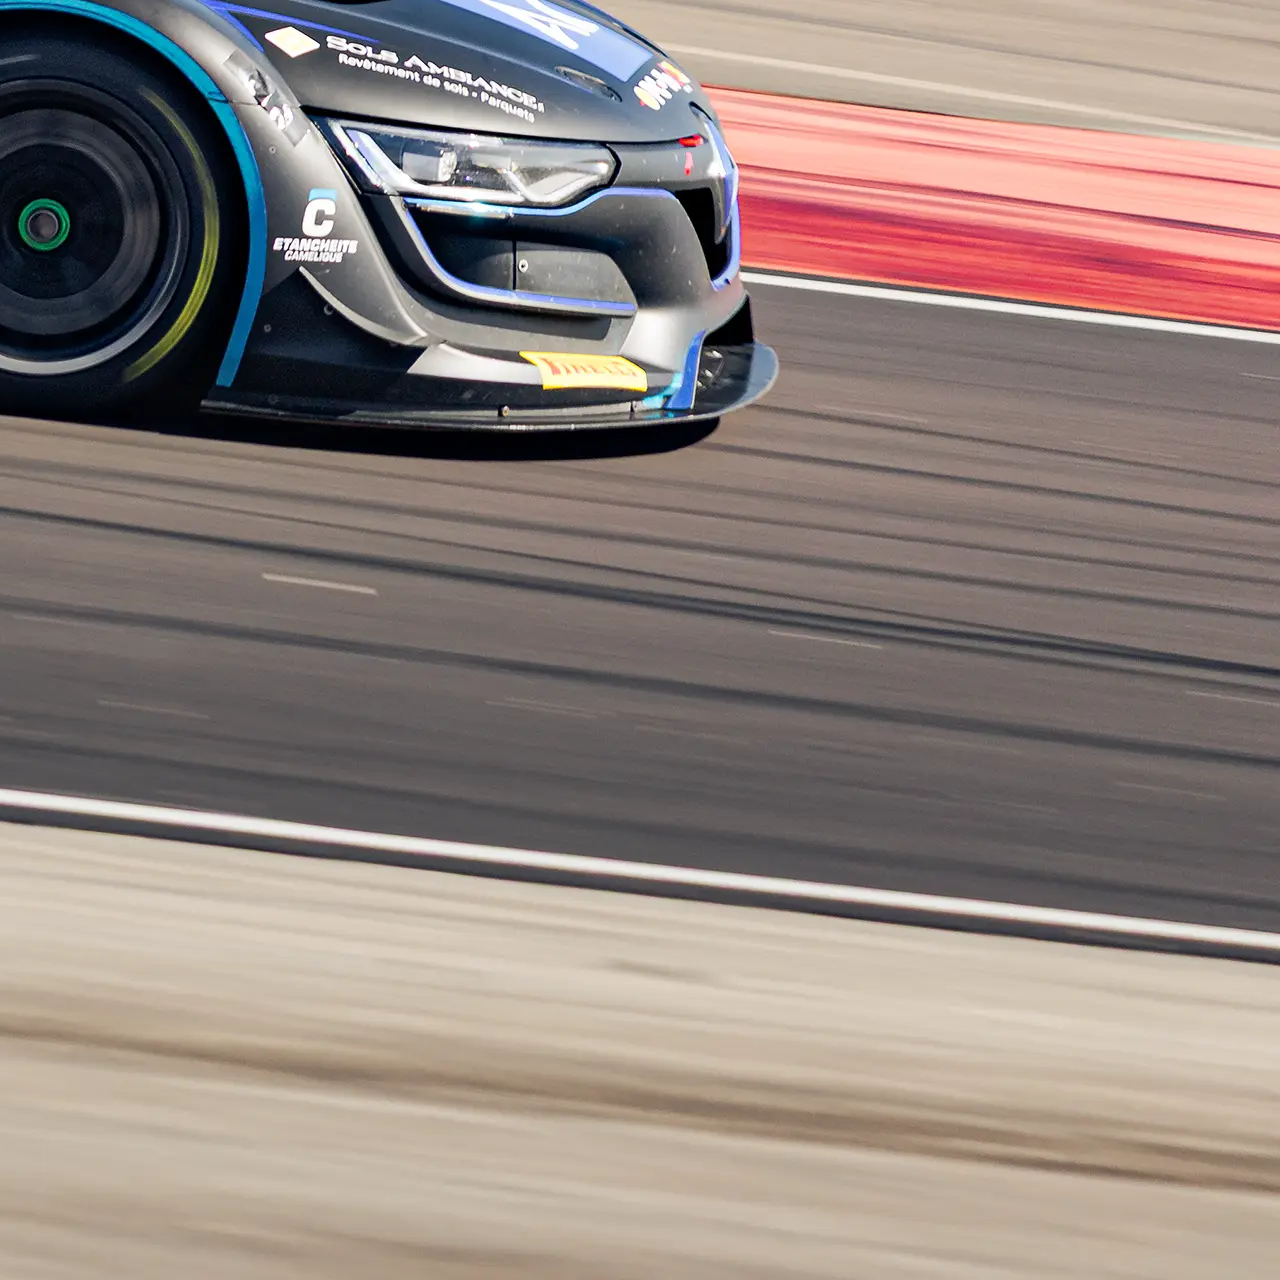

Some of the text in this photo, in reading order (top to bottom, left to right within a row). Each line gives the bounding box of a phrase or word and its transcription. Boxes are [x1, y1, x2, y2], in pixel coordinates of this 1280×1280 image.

[338, 53, 420, 82] Revêtement
[423, 74, 440, 87] de
[444, 81, 469, 97] sols
[481, 91, 535, 123] Parquets
[273, 237, 359, 254] ETANCHEITE
